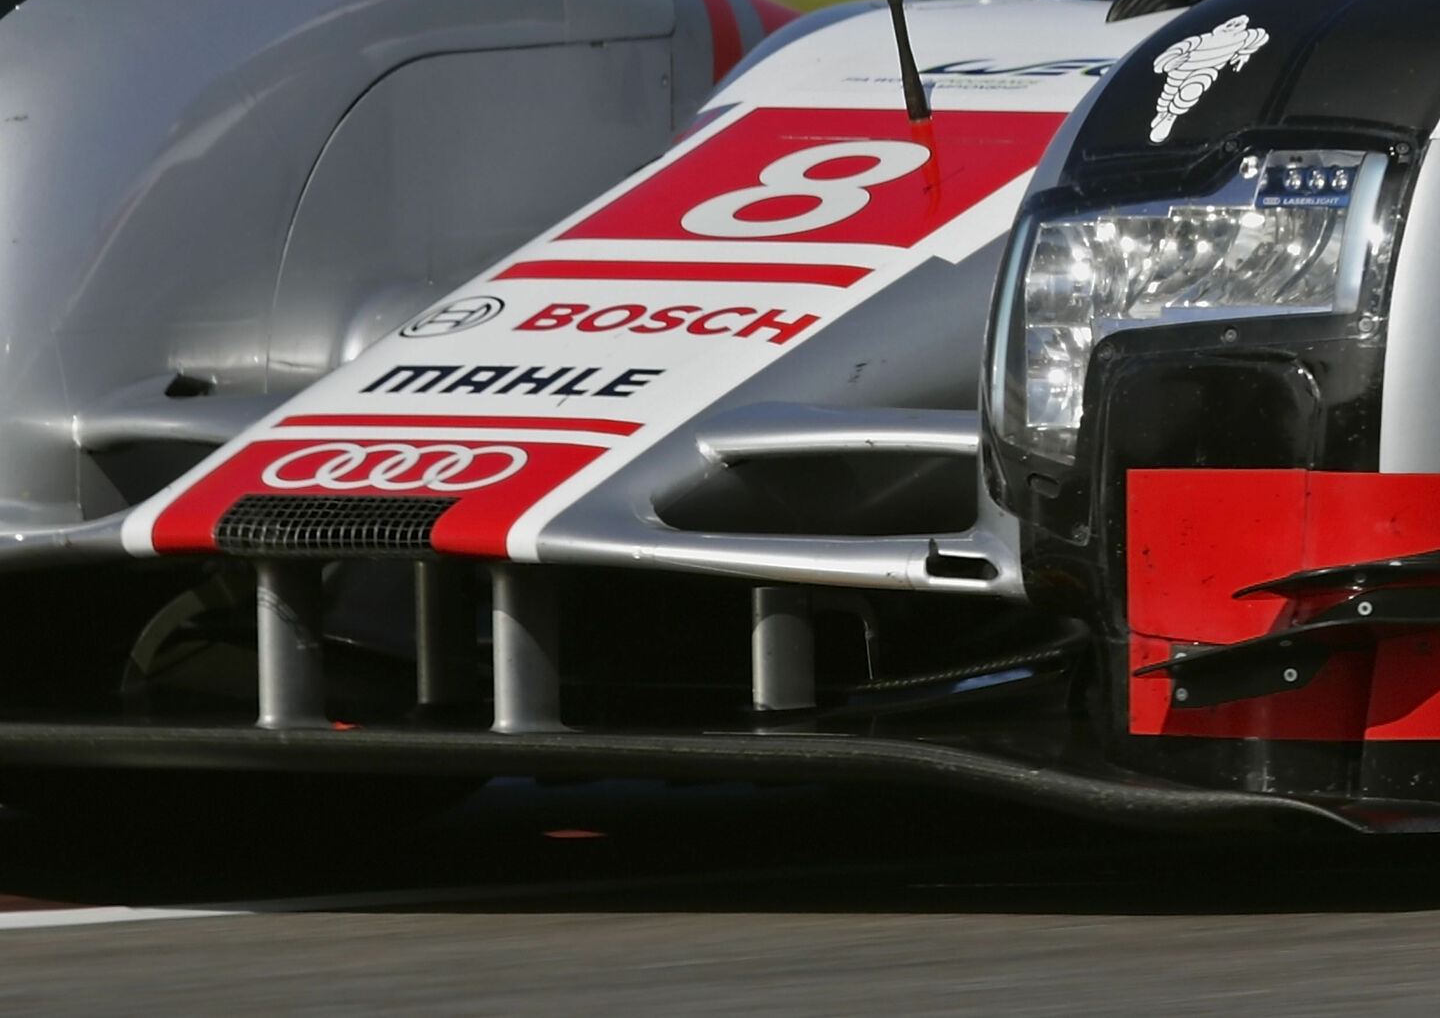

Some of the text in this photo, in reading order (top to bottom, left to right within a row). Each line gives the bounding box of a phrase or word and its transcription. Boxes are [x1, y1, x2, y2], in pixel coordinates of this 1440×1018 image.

[680, 139, 932, 239] 8
[1283, 197, 1340, 206] LASERLIGHT
[512, 302, 822, 346] BOSCH
[360, 365, 667, 398] MAHLE
